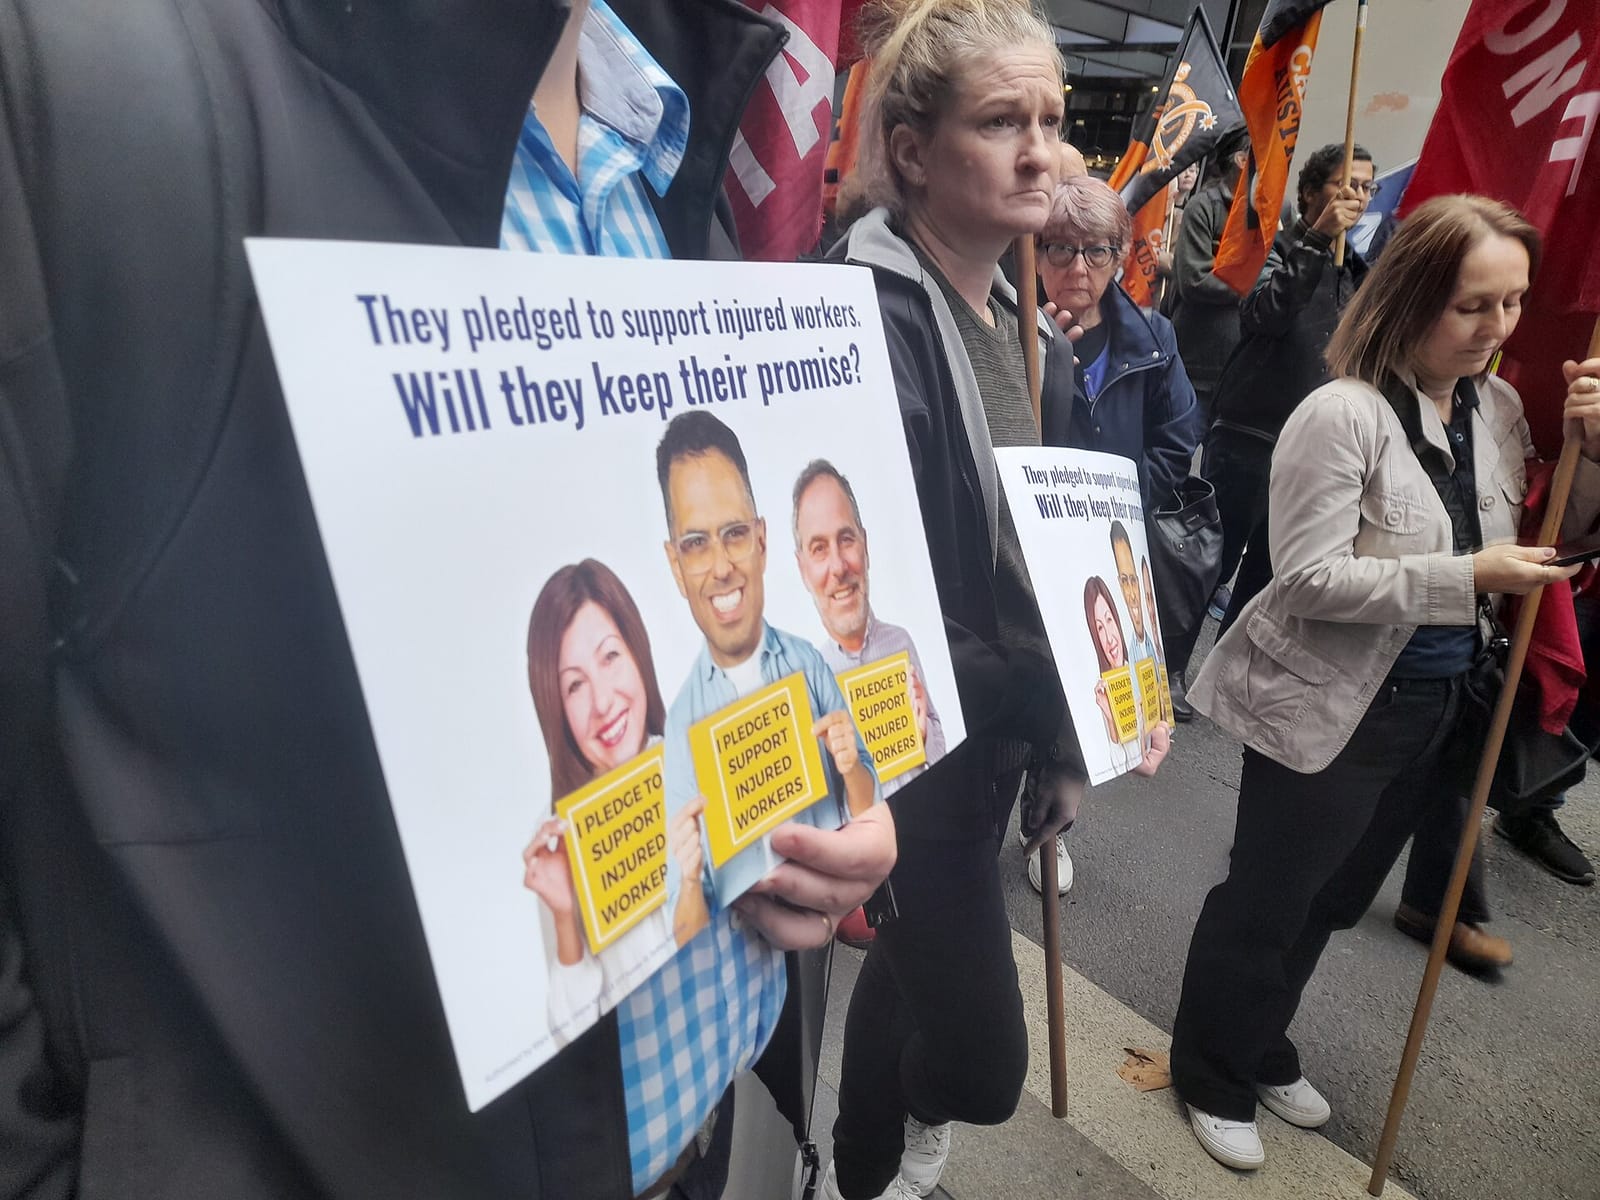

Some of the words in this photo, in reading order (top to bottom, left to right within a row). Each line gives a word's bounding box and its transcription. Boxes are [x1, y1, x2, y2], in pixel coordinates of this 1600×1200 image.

[357, 295, 450, 351] They
[463, 296, 582, 352] pledged
[587, 300, 614, 339] to
[623, 300, 710, 346] support
[714, 298, 787, 340] injured
[792, 297, 862, 330] workers.
[393, 368, 491, 438] Will
[500, 366, 585, 430] they
[592, 361, 673, 419] keep
[679, 353, 748, 405] their
[757, 342, 862, 406] promise?
[1022, 465, 1049, 487] They
[1050, 465, 1084, 488] pledged
[1082, 468, 1092, 486] to
[1034, 493, 1063, 519] Will
[1063, 493, 1089, 522] they
[1088, 494, 1112, 523] keep
[855, 675, 894, 701] PLEDGE
[894, 671, 907, 685] TO
[858, 692, 906, 722] SUPPORT
[723, 712, 771, 750] PLEDGE
[772, 702, 790, 720] TO
[864, 715, 909, 745] INJURED
[728, 727, 788, 775] SUPPORT
[735, 755, 792, 801] INJURED
[585, 785, 643, 834] PLEDGE
[643, 773, 662, 795] TO
[735, 776, 803, 830] WORKERS
[591, 801, 662, 861] SUPPORT
[601, 833, 666, 891] INJURED
